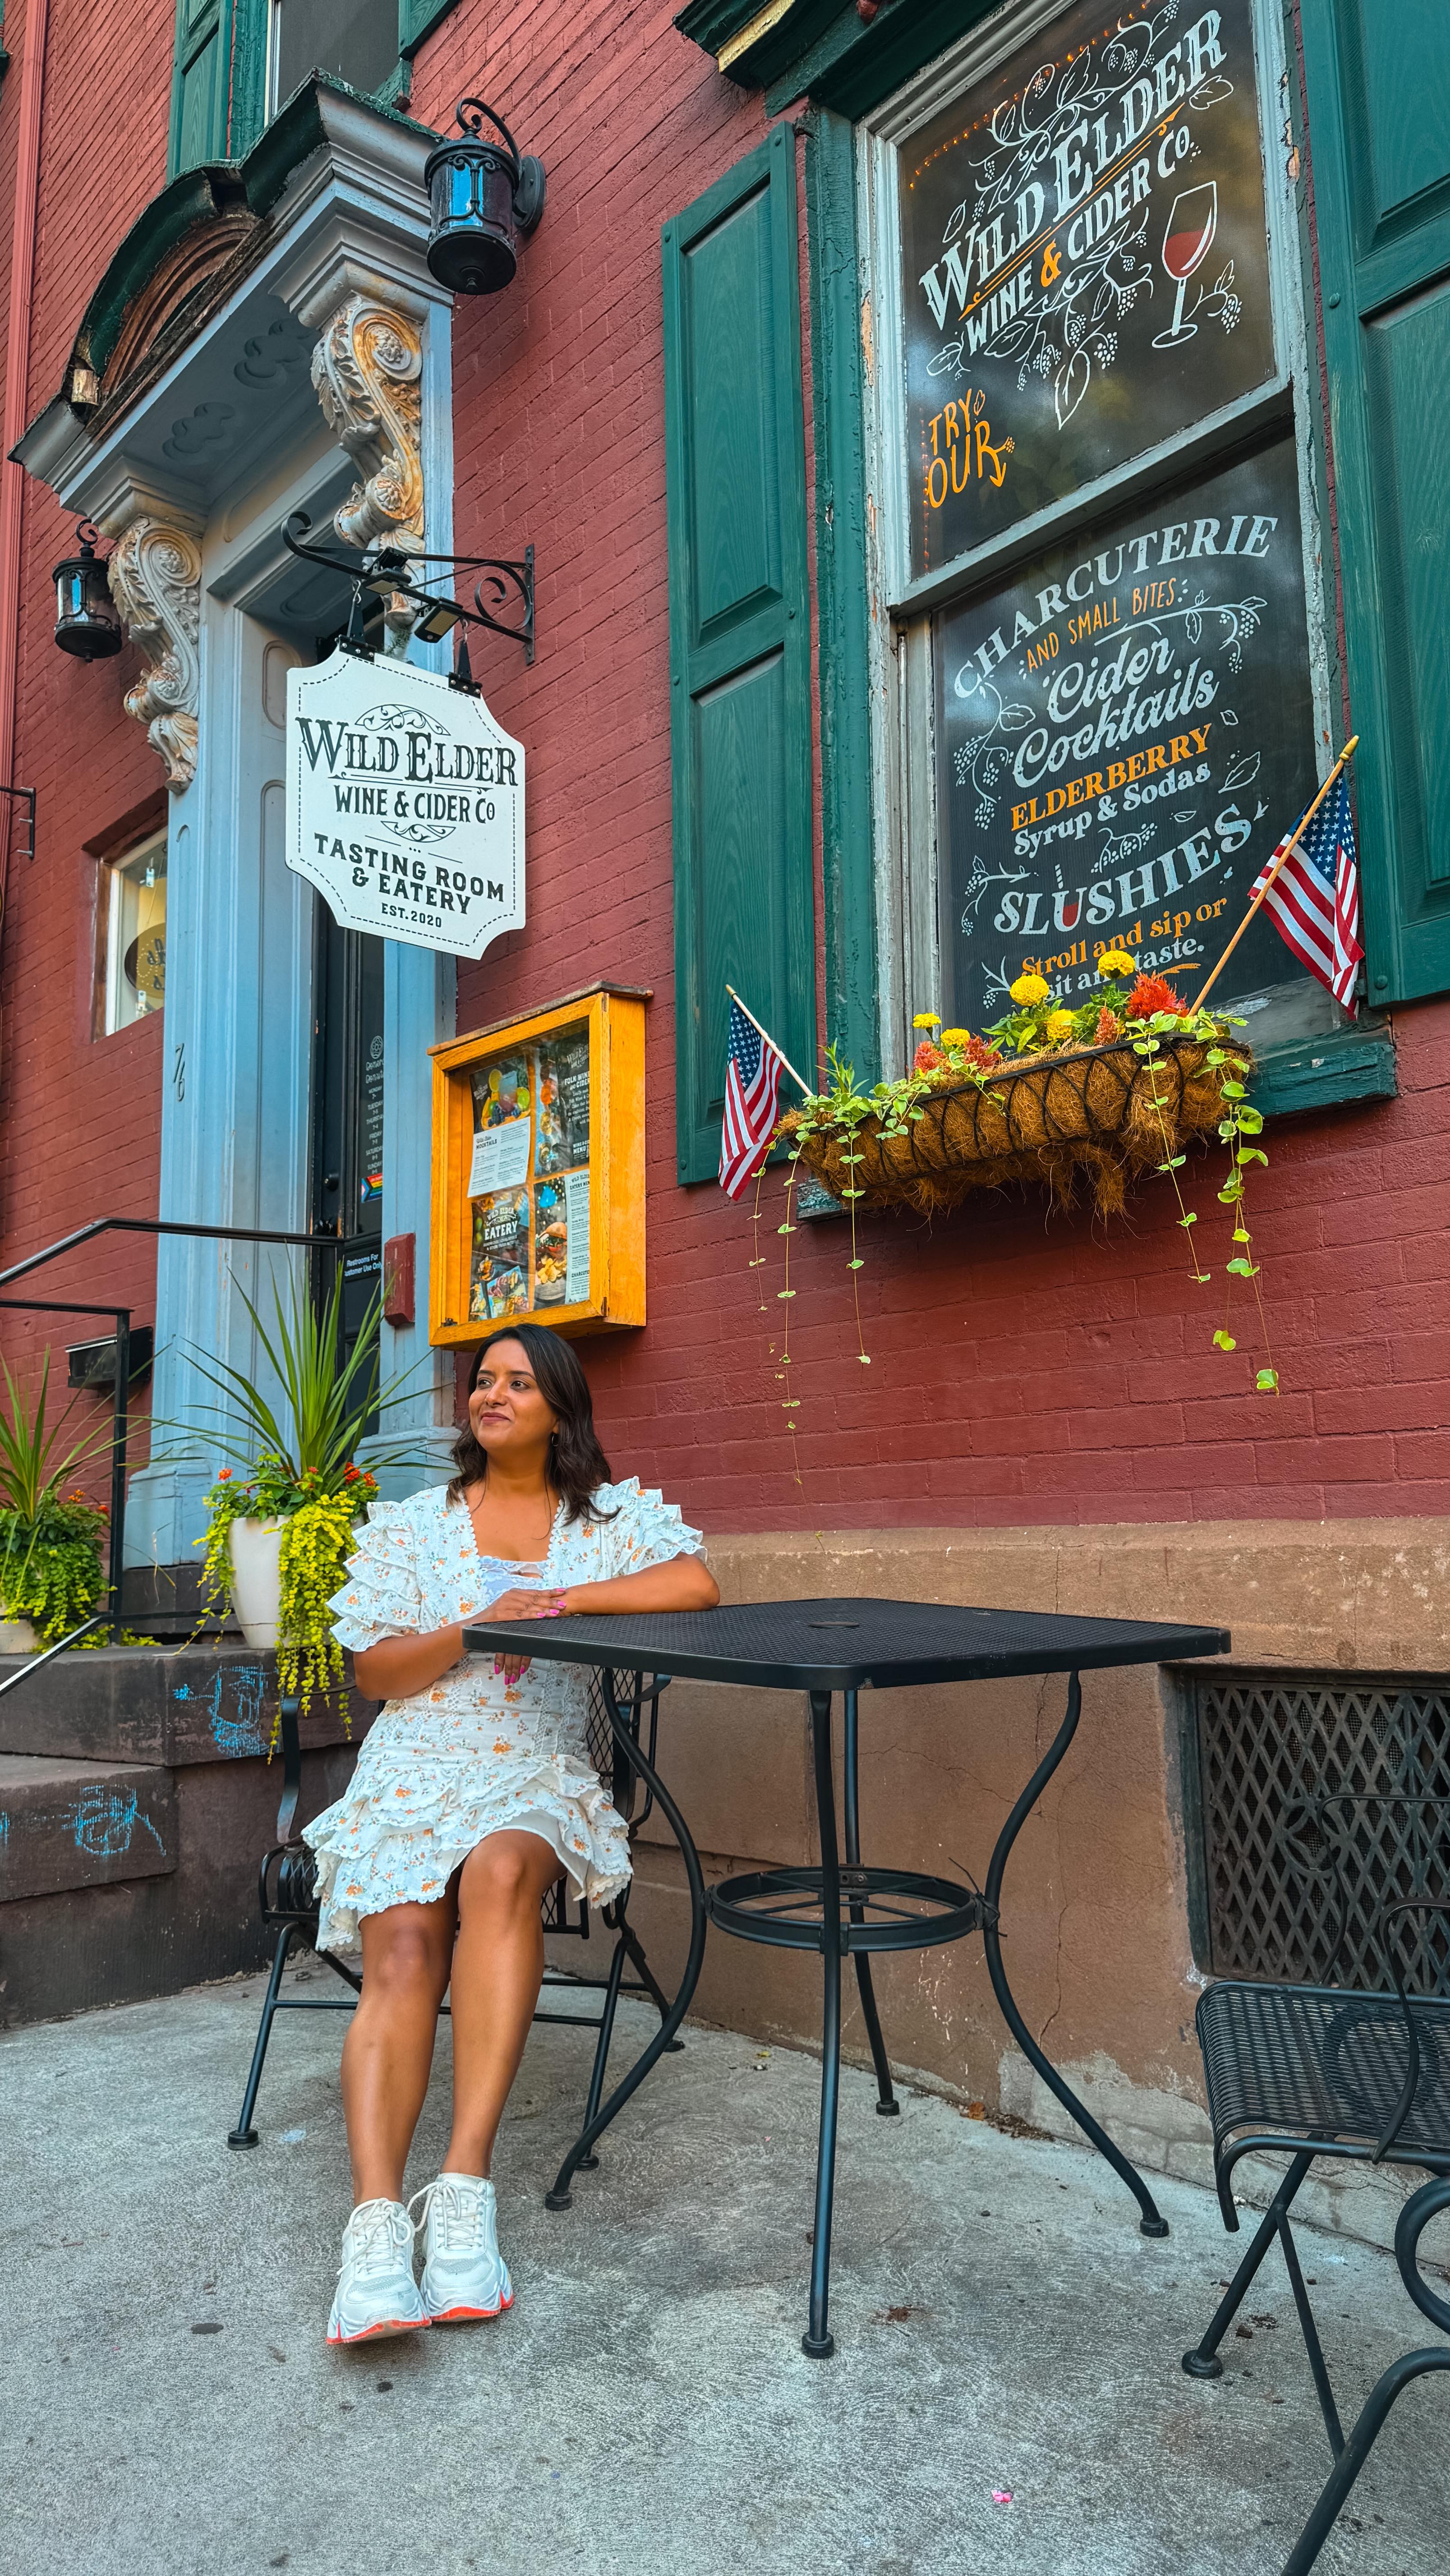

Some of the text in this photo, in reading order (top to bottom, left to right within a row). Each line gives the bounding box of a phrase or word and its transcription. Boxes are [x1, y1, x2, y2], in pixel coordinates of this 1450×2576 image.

[919, 10, 1227, 330] WILD ELDER
[966, 264, 1033, 354] WINE
[1041, 241, 1062, 287] &
[1067, 164, 1151, 260] CIDER
[928, 388, 972, 456] TRY
[927, 420, 1007, 507] OUR
[954, 515, 1279, 698] CHARCUTERIE
[1026, 578, 1177, 673] AND SMALL BITES
[1046, 636, 1176, 724] Cider
[295, 717, 519, 787] WILD ELDER
[1011, 658, 1220, 788] Cocktails
[334, 785, 388, 816] WINE
[394, 791, 409, 818] &
[414, 792, 471, 823] CIDER
[1010, 723, 1212, 831] ELDERBERRY
[1014, 762, 1211, 858] Syrup & Sodas
[314, 833, 505, 902] TASTING ROOM
[352, 867, 471, 915] & EATERY
[994, 803, 1252, 935] SLUSHIES
[1022, 897, 1227, 978] Stroll and sip or
[1077, 970, 1111, 993] an
[1136, 937, 1204, 971] taste.
[564, 1076, 577, 1086] FOLK
[476, 1139, 497, 1150] MOCKTAILS
[346, 1256, 370, 1267] Restrooms
[484, 1220, 518, 1241] EATERY
[344, 1267, 362, 1277] ustomer
